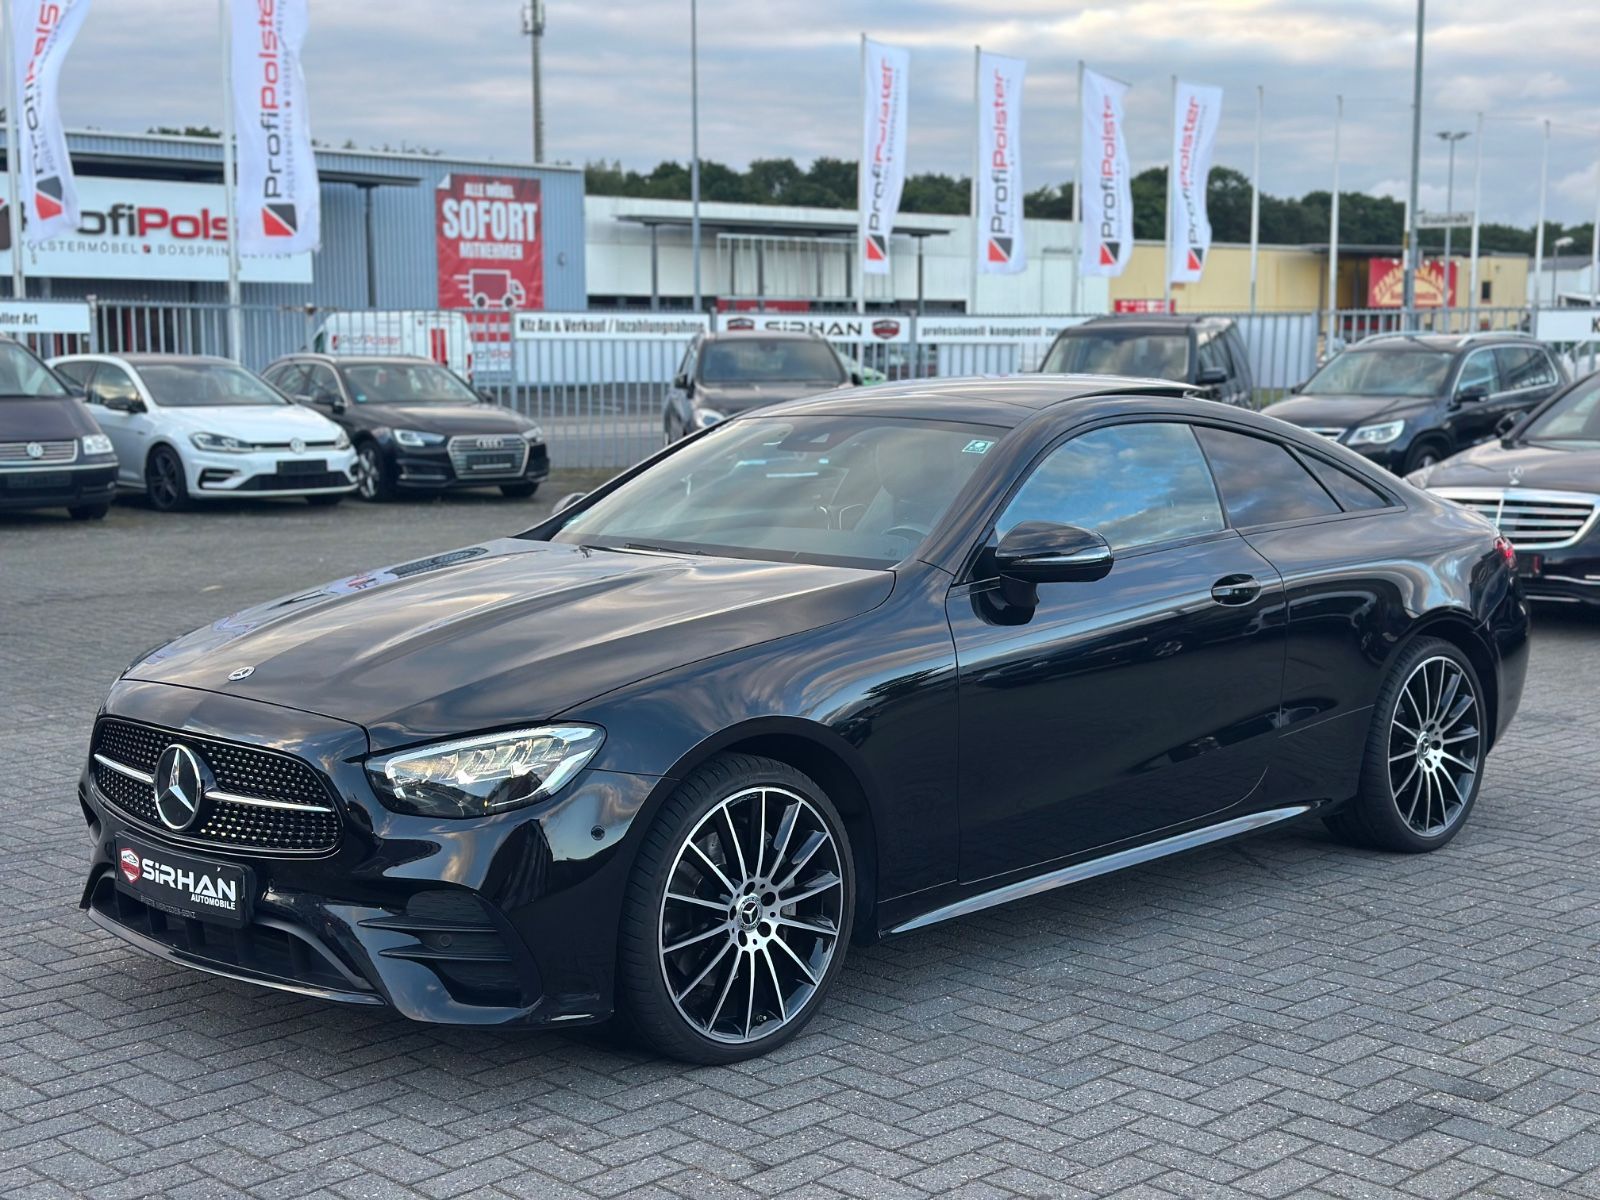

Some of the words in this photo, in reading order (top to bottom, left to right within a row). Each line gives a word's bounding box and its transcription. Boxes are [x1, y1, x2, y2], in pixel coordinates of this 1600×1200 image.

[442, 198, 537, 242] SOFORT
[0, 311, 20, 325] ller
[22, 311, 38, 326] Art
[520, 318, 536, 332] Kfz
[538, 318, 551, 332] An
[554, 321, 562, 332] &
[563, 317, 607, 332] Verkauf
[989, 325, 1042, 337] kompetent
[190, 893, 236, 911] AUTOMOBILE
